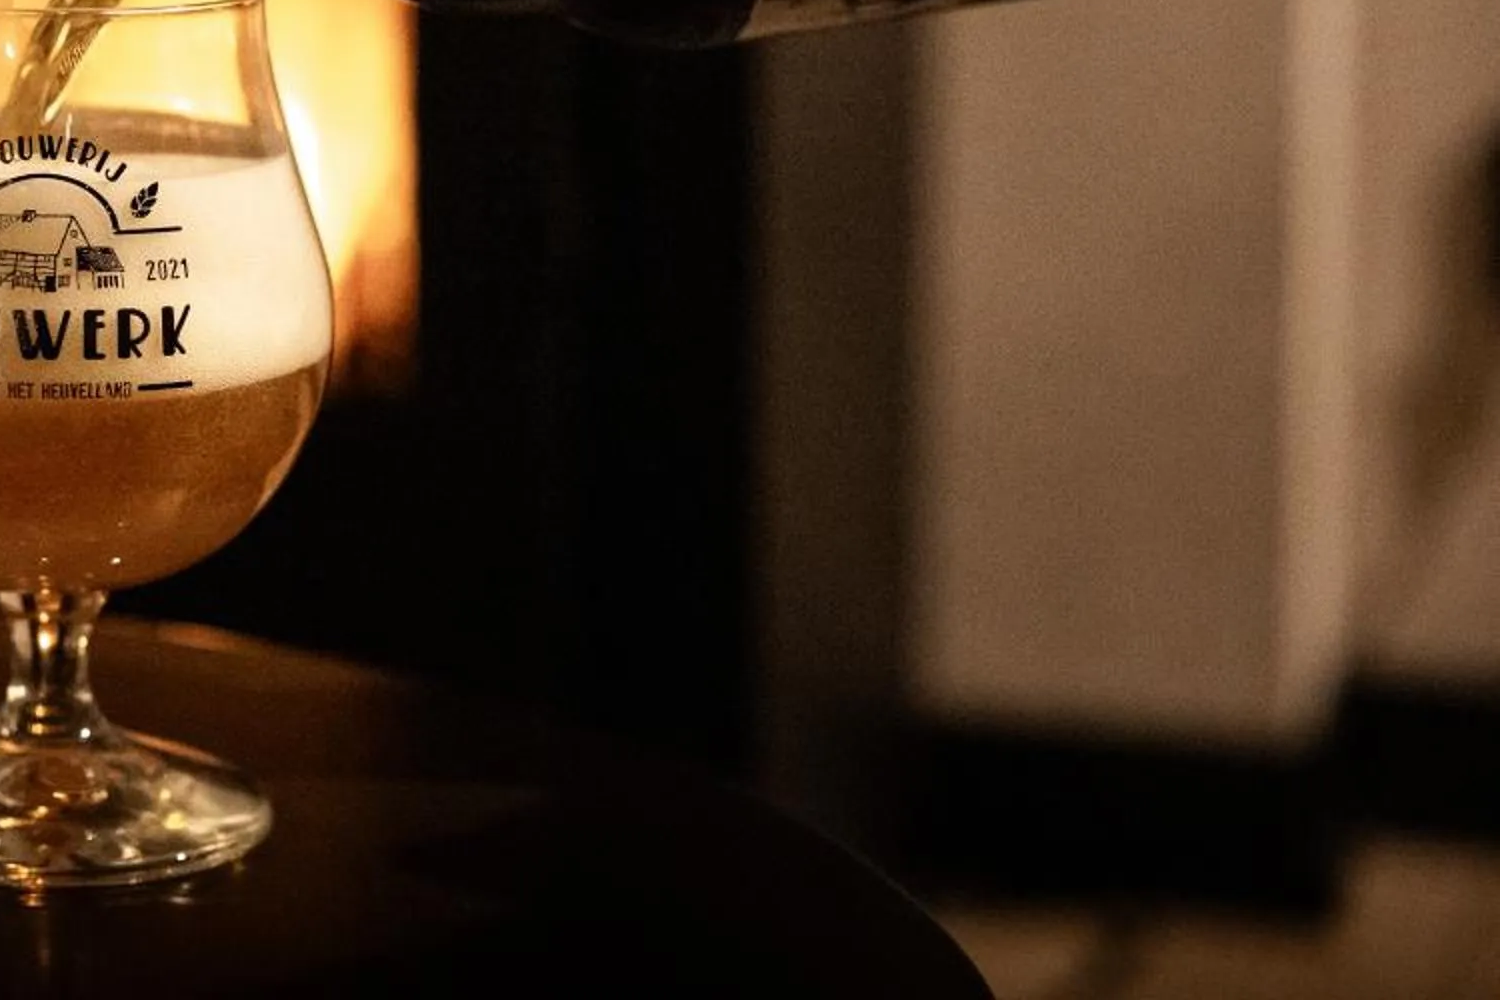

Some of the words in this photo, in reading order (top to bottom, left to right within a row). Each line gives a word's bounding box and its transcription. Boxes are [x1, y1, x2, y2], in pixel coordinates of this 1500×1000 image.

[145, 257, 190, 281] 2021
[7, 381, 34, 399] HET
[41, 381, 132, 399] HEUVELLAND
